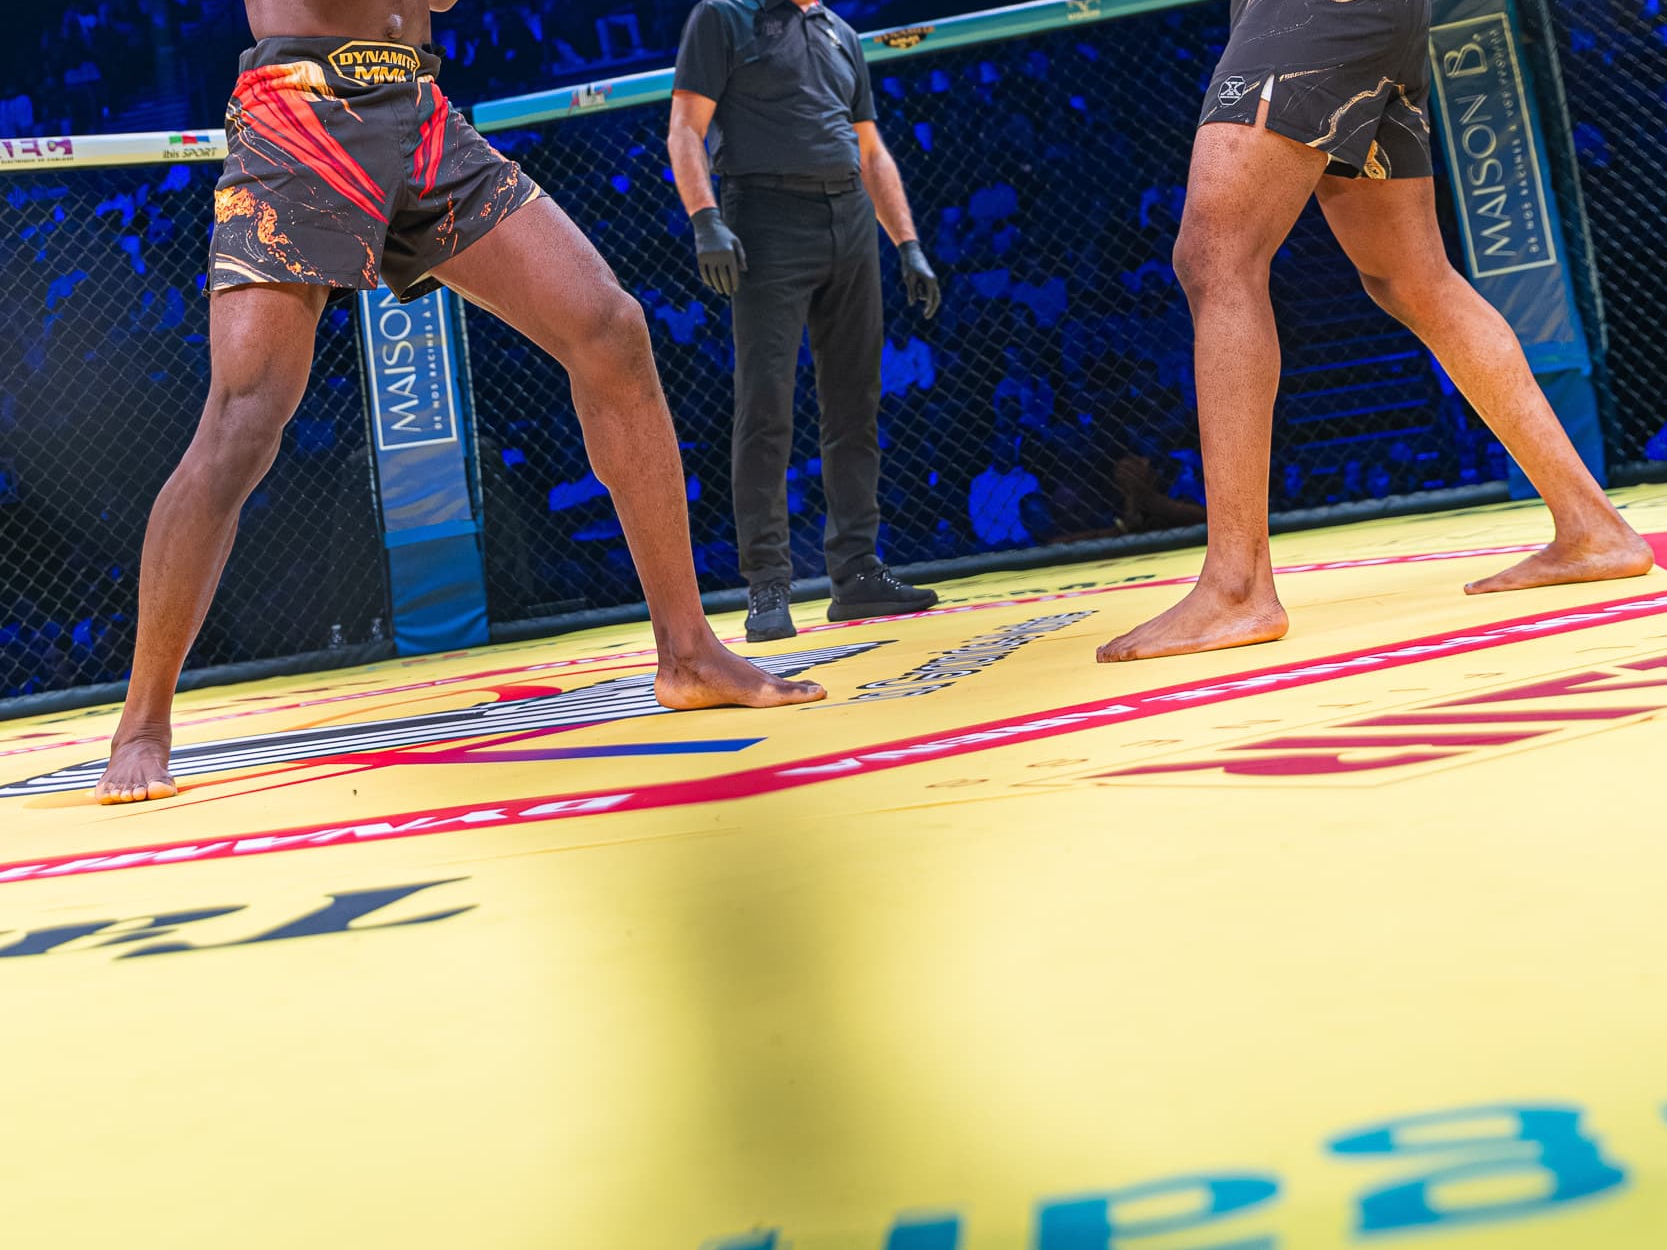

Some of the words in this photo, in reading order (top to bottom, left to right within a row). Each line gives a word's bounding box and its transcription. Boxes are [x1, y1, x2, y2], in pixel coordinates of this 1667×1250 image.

[354, 66, 408, 84] MMA
[162, 149, 180, 159] ibis
[182, 146, 218, 158] SPORT
[1454, 93, 1518, 257] MAISON
[424, 323, 438, 378] RACINES
[430, 383, 441, 409] NOS
[1140, 633, 1508, 702] FRANCE
[772, 703, 1140, 777] ARENA
